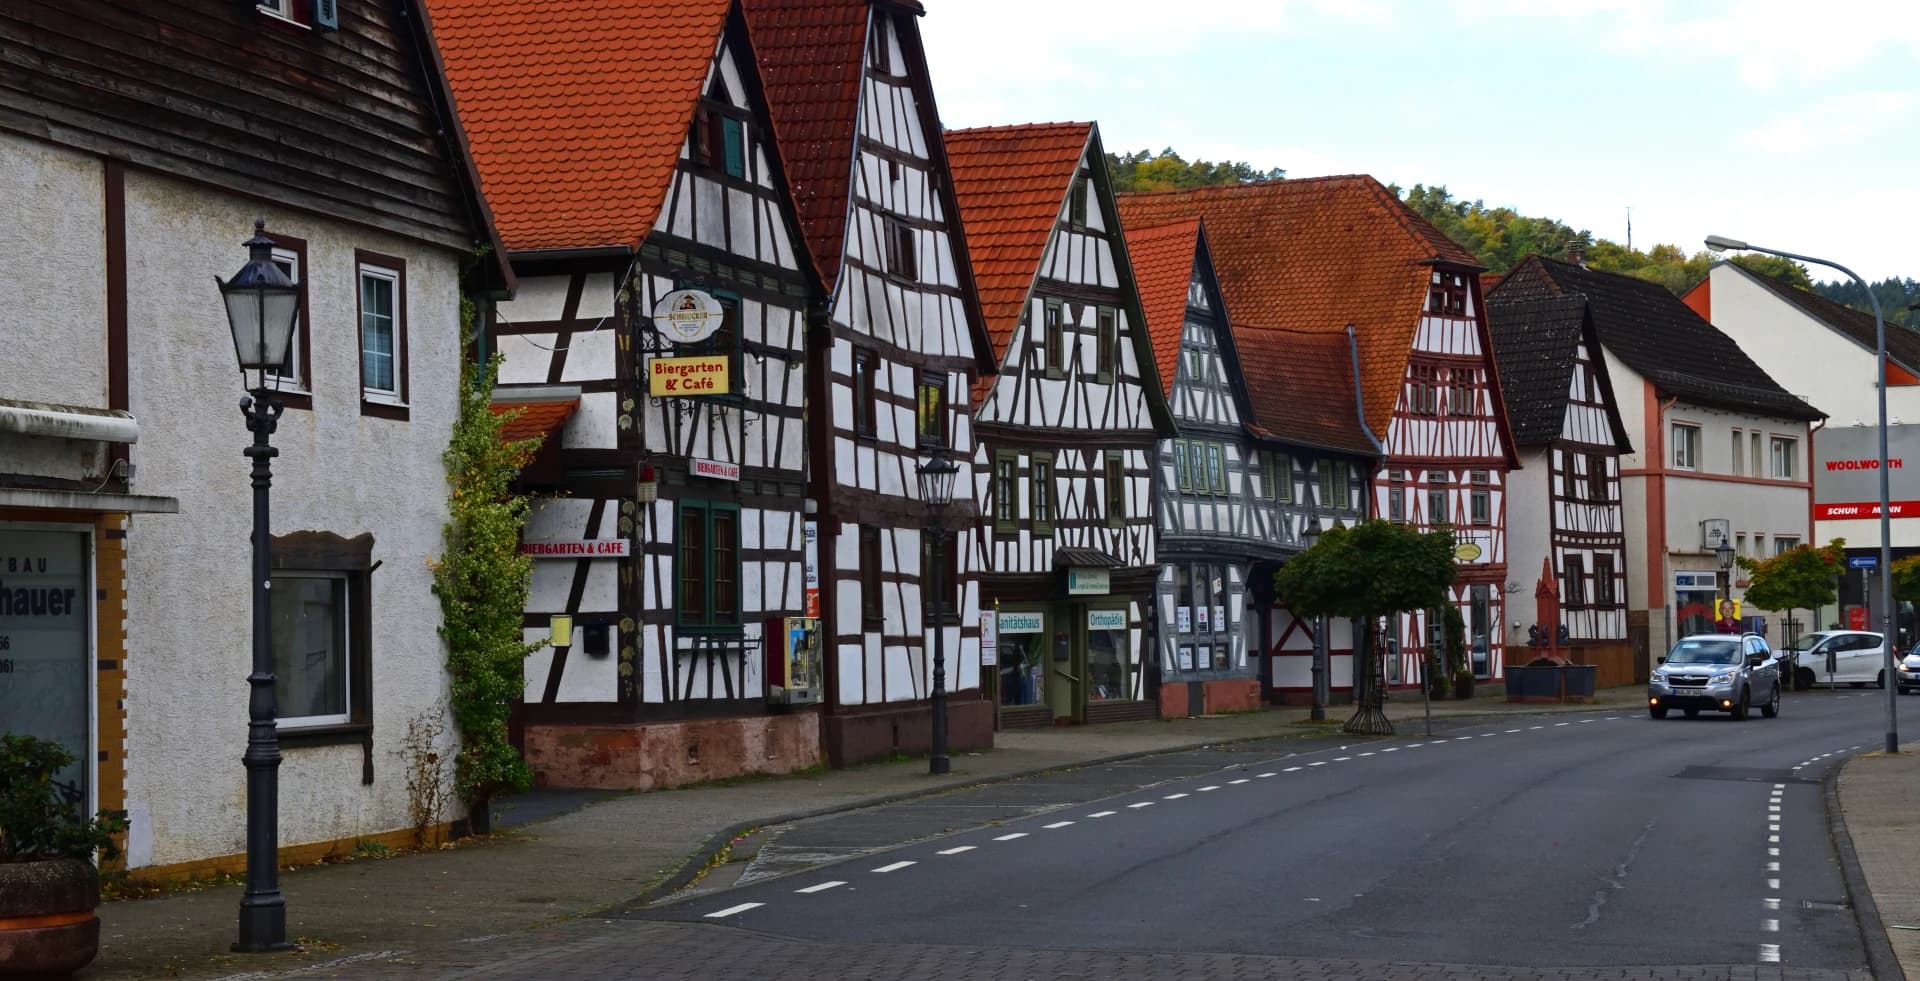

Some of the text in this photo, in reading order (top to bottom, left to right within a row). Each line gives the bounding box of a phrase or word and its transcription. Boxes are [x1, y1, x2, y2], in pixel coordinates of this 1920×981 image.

[655, 363, 723, 377] Biergarten
[665, 378, 714, 390] & Café
[1826, 459, 1903, 471] WOOLWOTH
[1827, 506, 1902, 515] SCHUH MNN
[521, 542, 623, 554] BIERGARTEN & CAFE
[999, 615, 1040, 630] anitätshaus
[1090, 613, 1123, 628] Orthopädie
